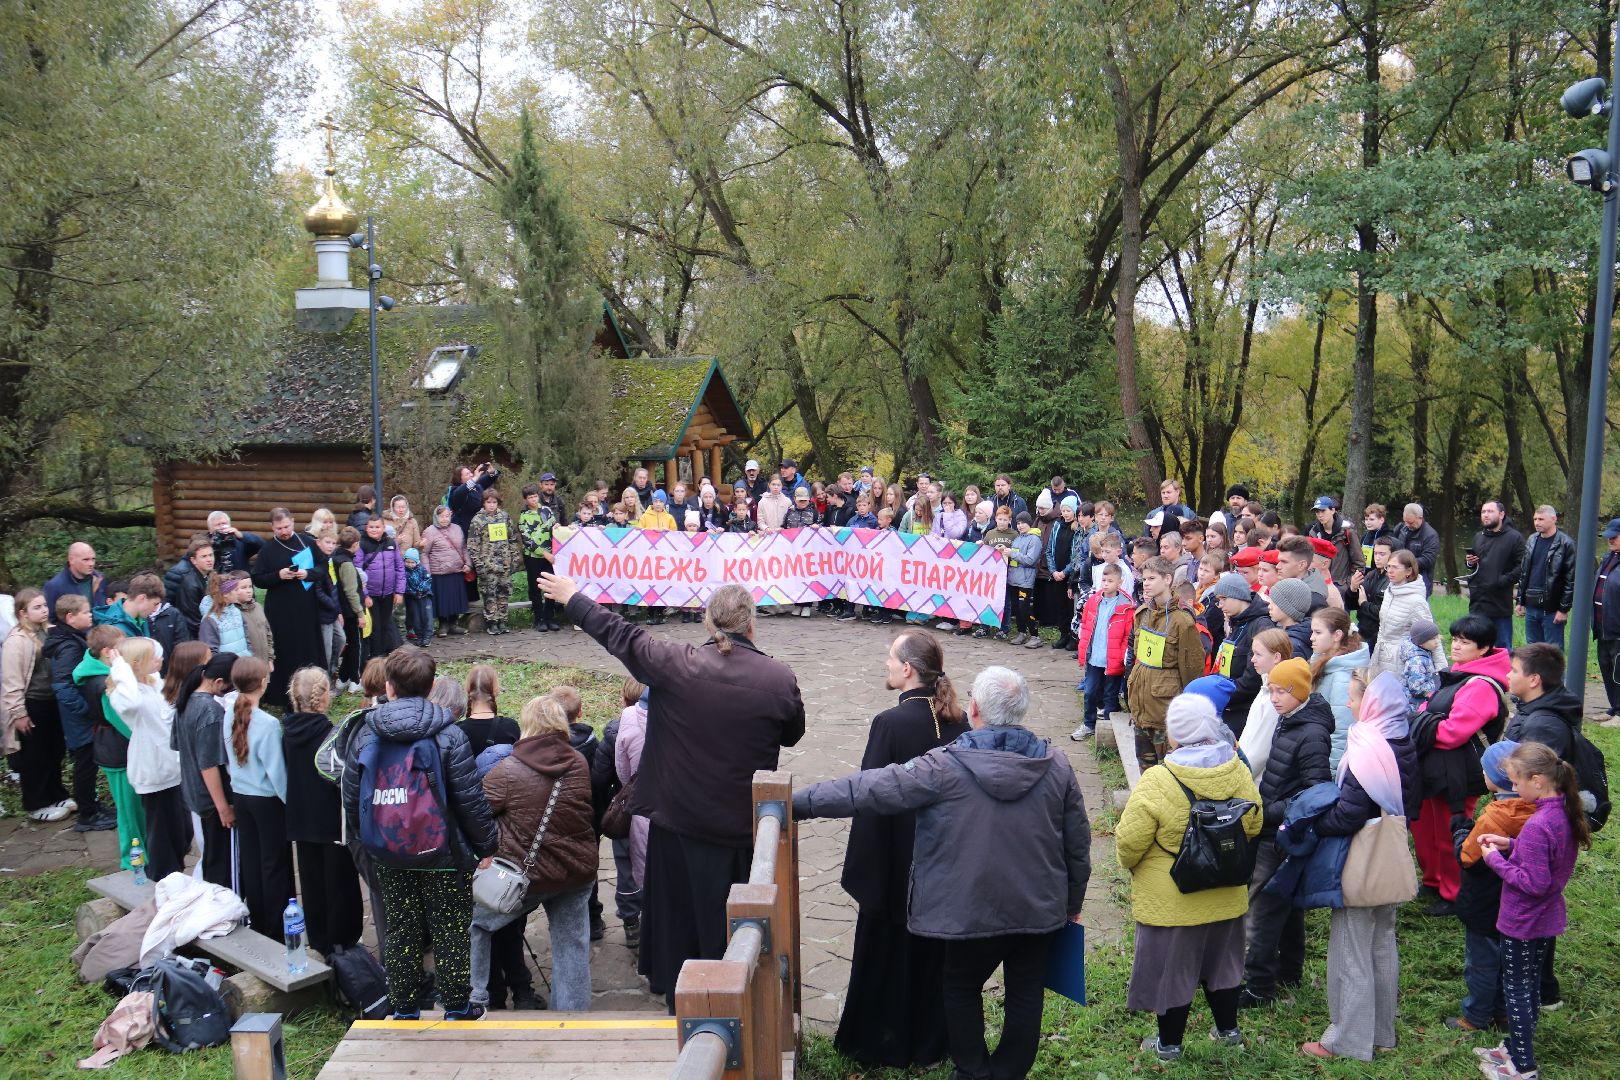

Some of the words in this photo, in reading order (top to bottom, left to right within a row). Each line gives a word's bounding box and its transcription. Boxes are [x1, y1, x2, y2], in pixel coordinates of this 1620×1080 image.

[568, 552, 707, 584] МОЛОДЕЖЬ
[722, 550, 884, 584] КОЛОМЕНСКОЙ
[900, 559, 998, 600] ЕПАРХИИ
[1146, 646, 1152, 658] 9
[371, 787, 408, 805] ОССИ
